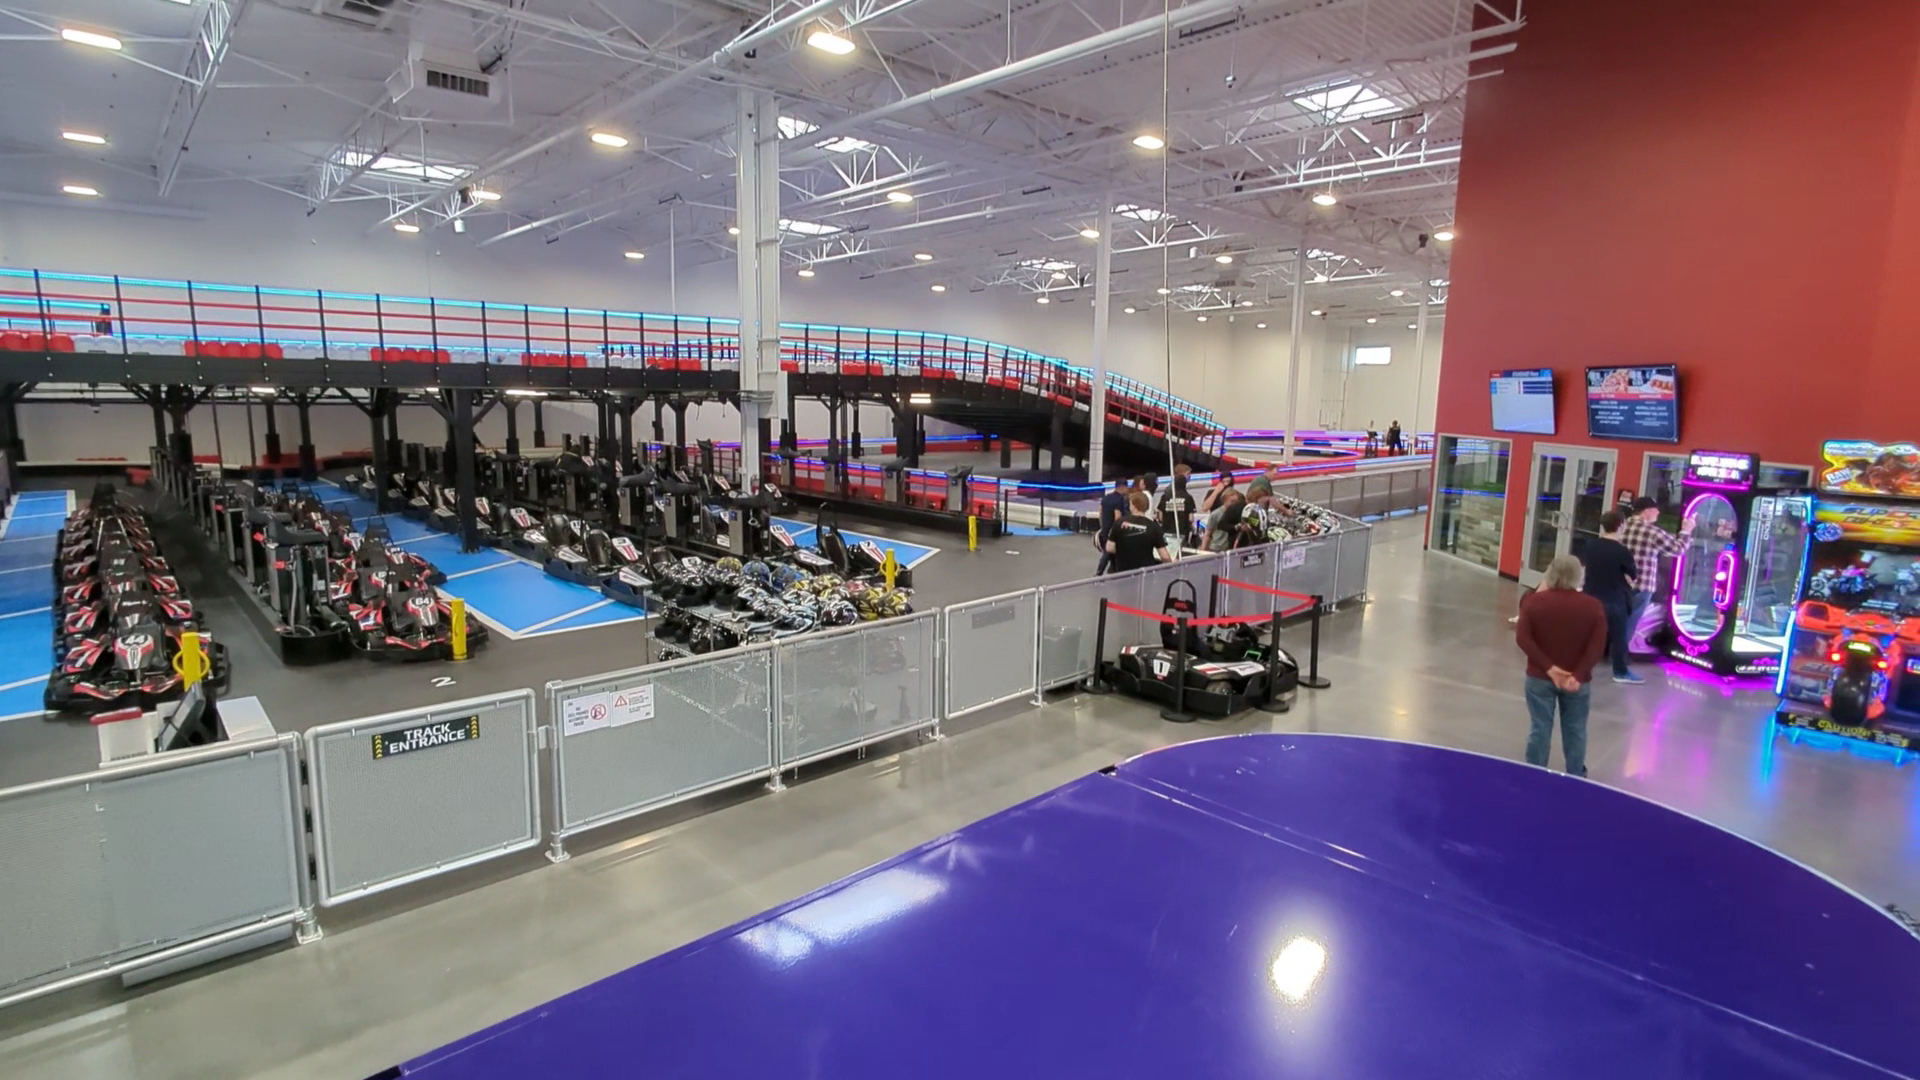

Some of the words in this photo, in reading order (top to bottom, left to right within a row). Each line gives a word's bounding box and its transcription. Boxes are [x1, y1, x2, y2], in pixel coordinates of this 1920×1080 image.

[430, 676, 457, 688] 2
[404, 722, 451, 740] TRACK
[389, 729, 466, 754] ENTRANCE
